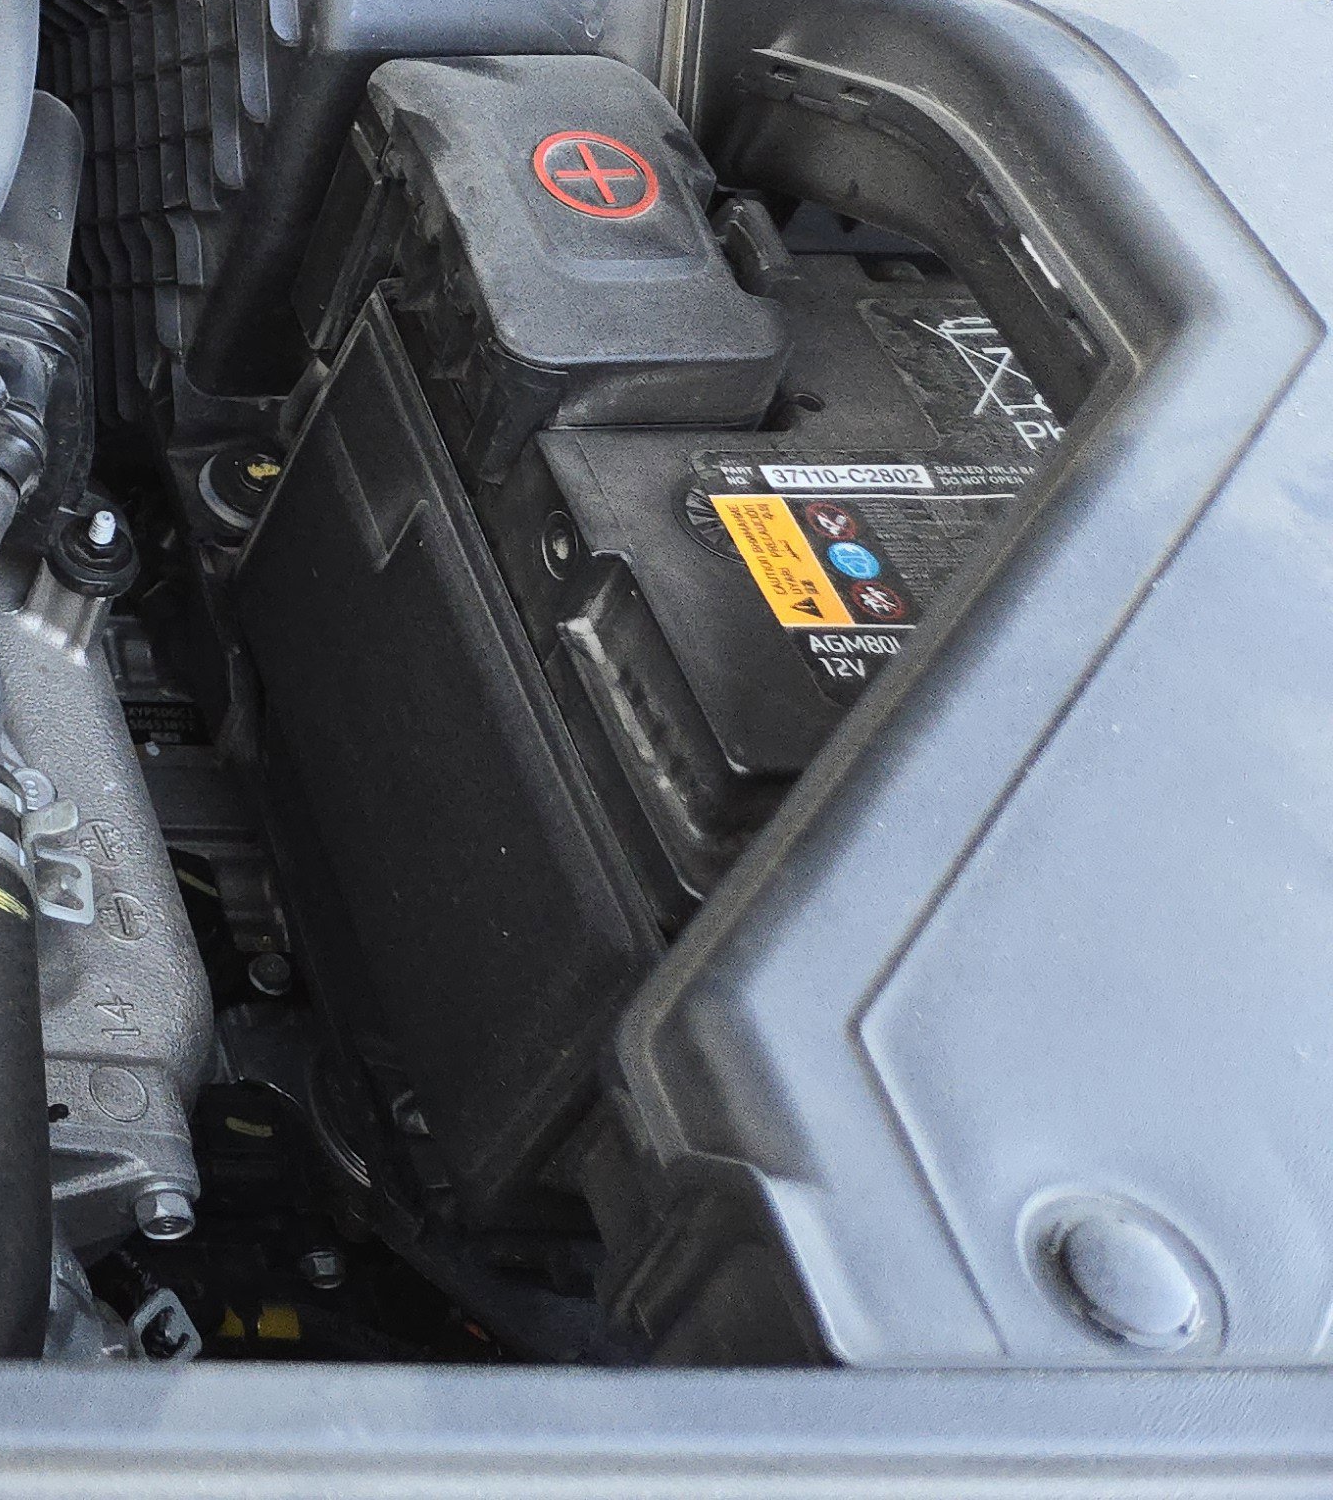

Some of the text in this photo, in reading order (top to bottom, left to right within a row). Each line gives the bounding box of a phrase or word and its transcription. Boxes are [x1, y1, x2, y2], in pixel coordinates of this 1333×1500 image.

[720, 466, 926, 487] PART 37110-C2802
[934, 465, 983, 476] SEALED
[940, 475, 1025, 486] DO NOT OPEN
[818, 657, 866, 678] 12V
